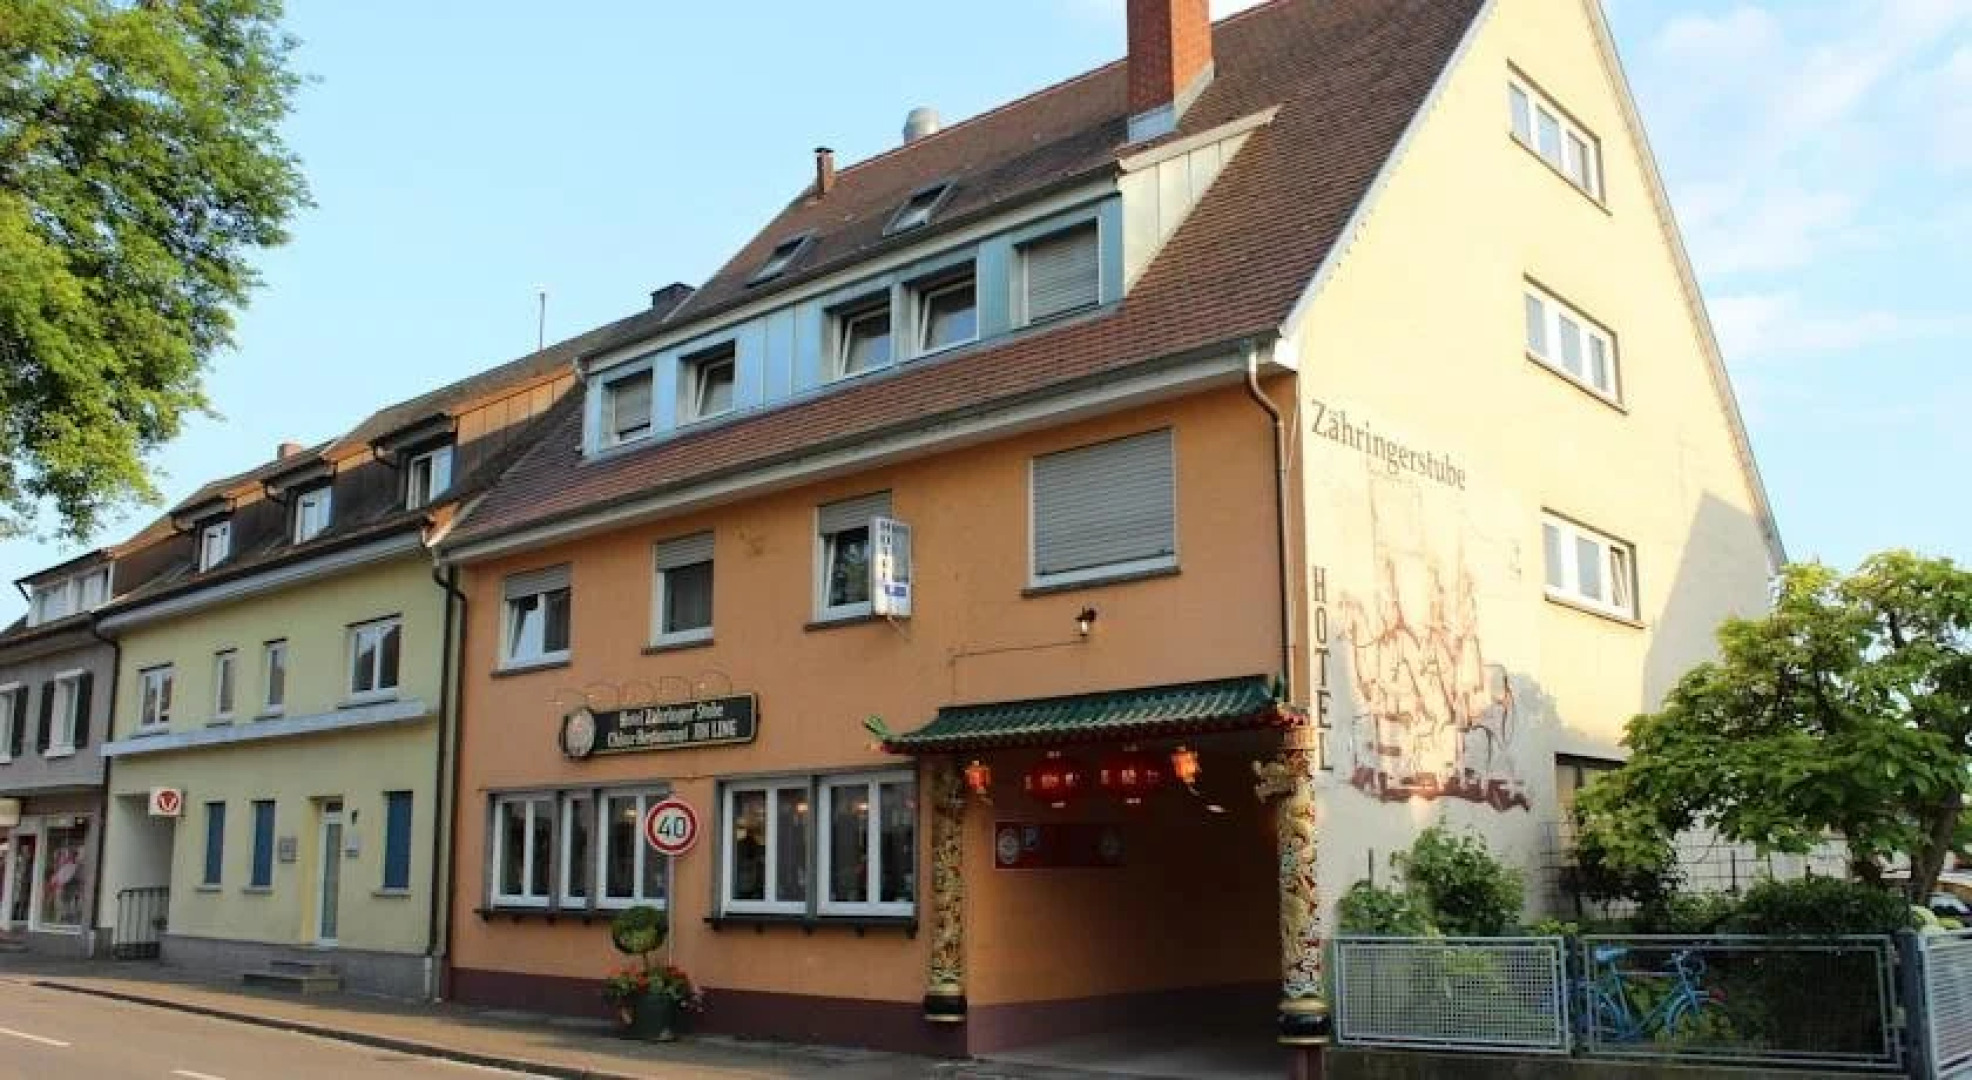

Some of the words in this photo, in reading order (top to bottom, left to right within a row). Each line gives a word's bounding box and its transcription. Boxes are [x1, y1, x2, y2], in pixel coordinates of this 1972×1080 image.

[1312, 399, 1466, 491] Zähringerstube
[1313, 566, 1333, 770] HOTEL
[657, 816, 686, 838] 40
